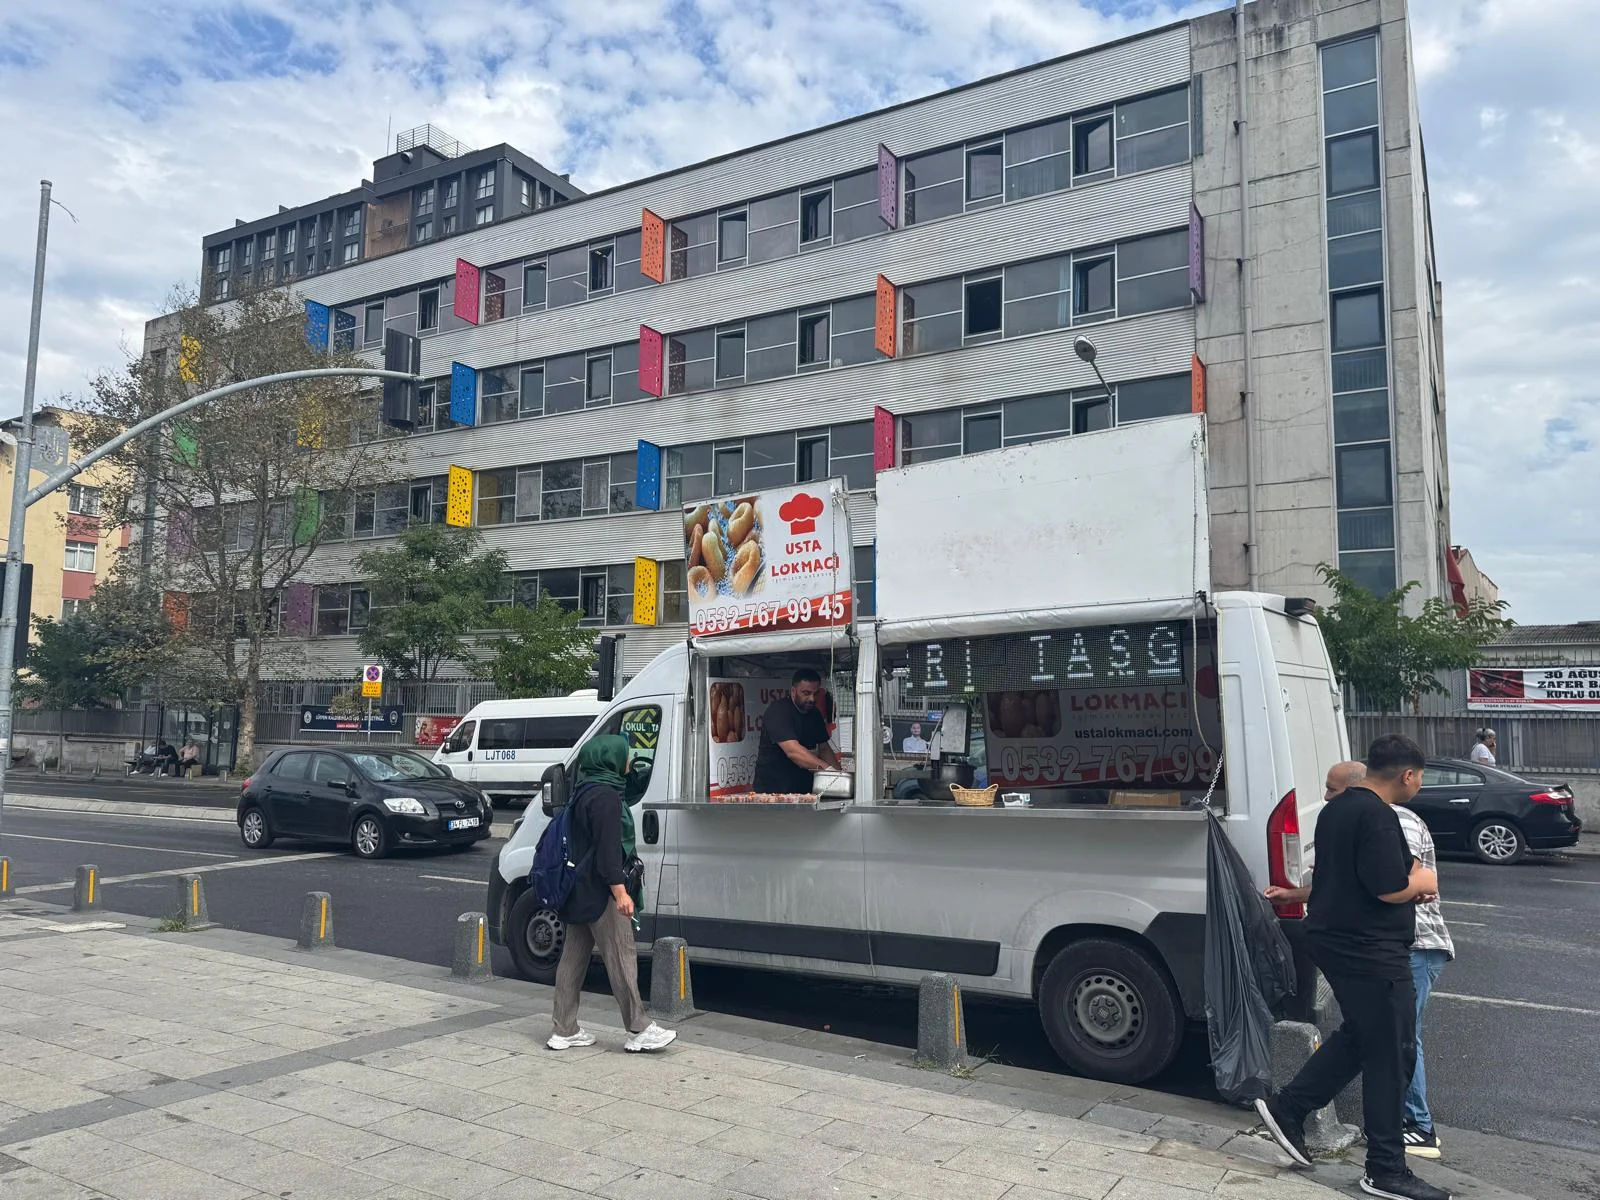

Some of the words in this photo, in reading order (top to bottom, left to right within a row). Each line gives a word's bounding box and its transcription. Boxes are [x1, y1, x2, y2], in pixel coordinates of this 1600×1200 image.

[785, 539, 822, 555] USTA
[771, 555, 840, 577] LOKMACI
[695, 605, 740, 633] 0532
[744, 600, 780, 628] 767
[786, 597, 812, 624] 99
[817, 594, 845, 620] 45
[1544, 670, 1563, 679] 30
[1568, 669, 1600, 679] AĞU
[1537, 680, 1584, 689] ZAFER
[1589, 680, 1600, 689] B
[1071, 690, 1187, 712] LOKMACI
[625, 722, 646, 732] OKUL
[1074, 726, 1193, 740] ustalokmaci.com
[485, 750, 516, 761] LJT068
[999, 744, 1082, 783] 0532
[1091, 743, 1160, 783] 767
[1171, 743, 1218, 783] 99
